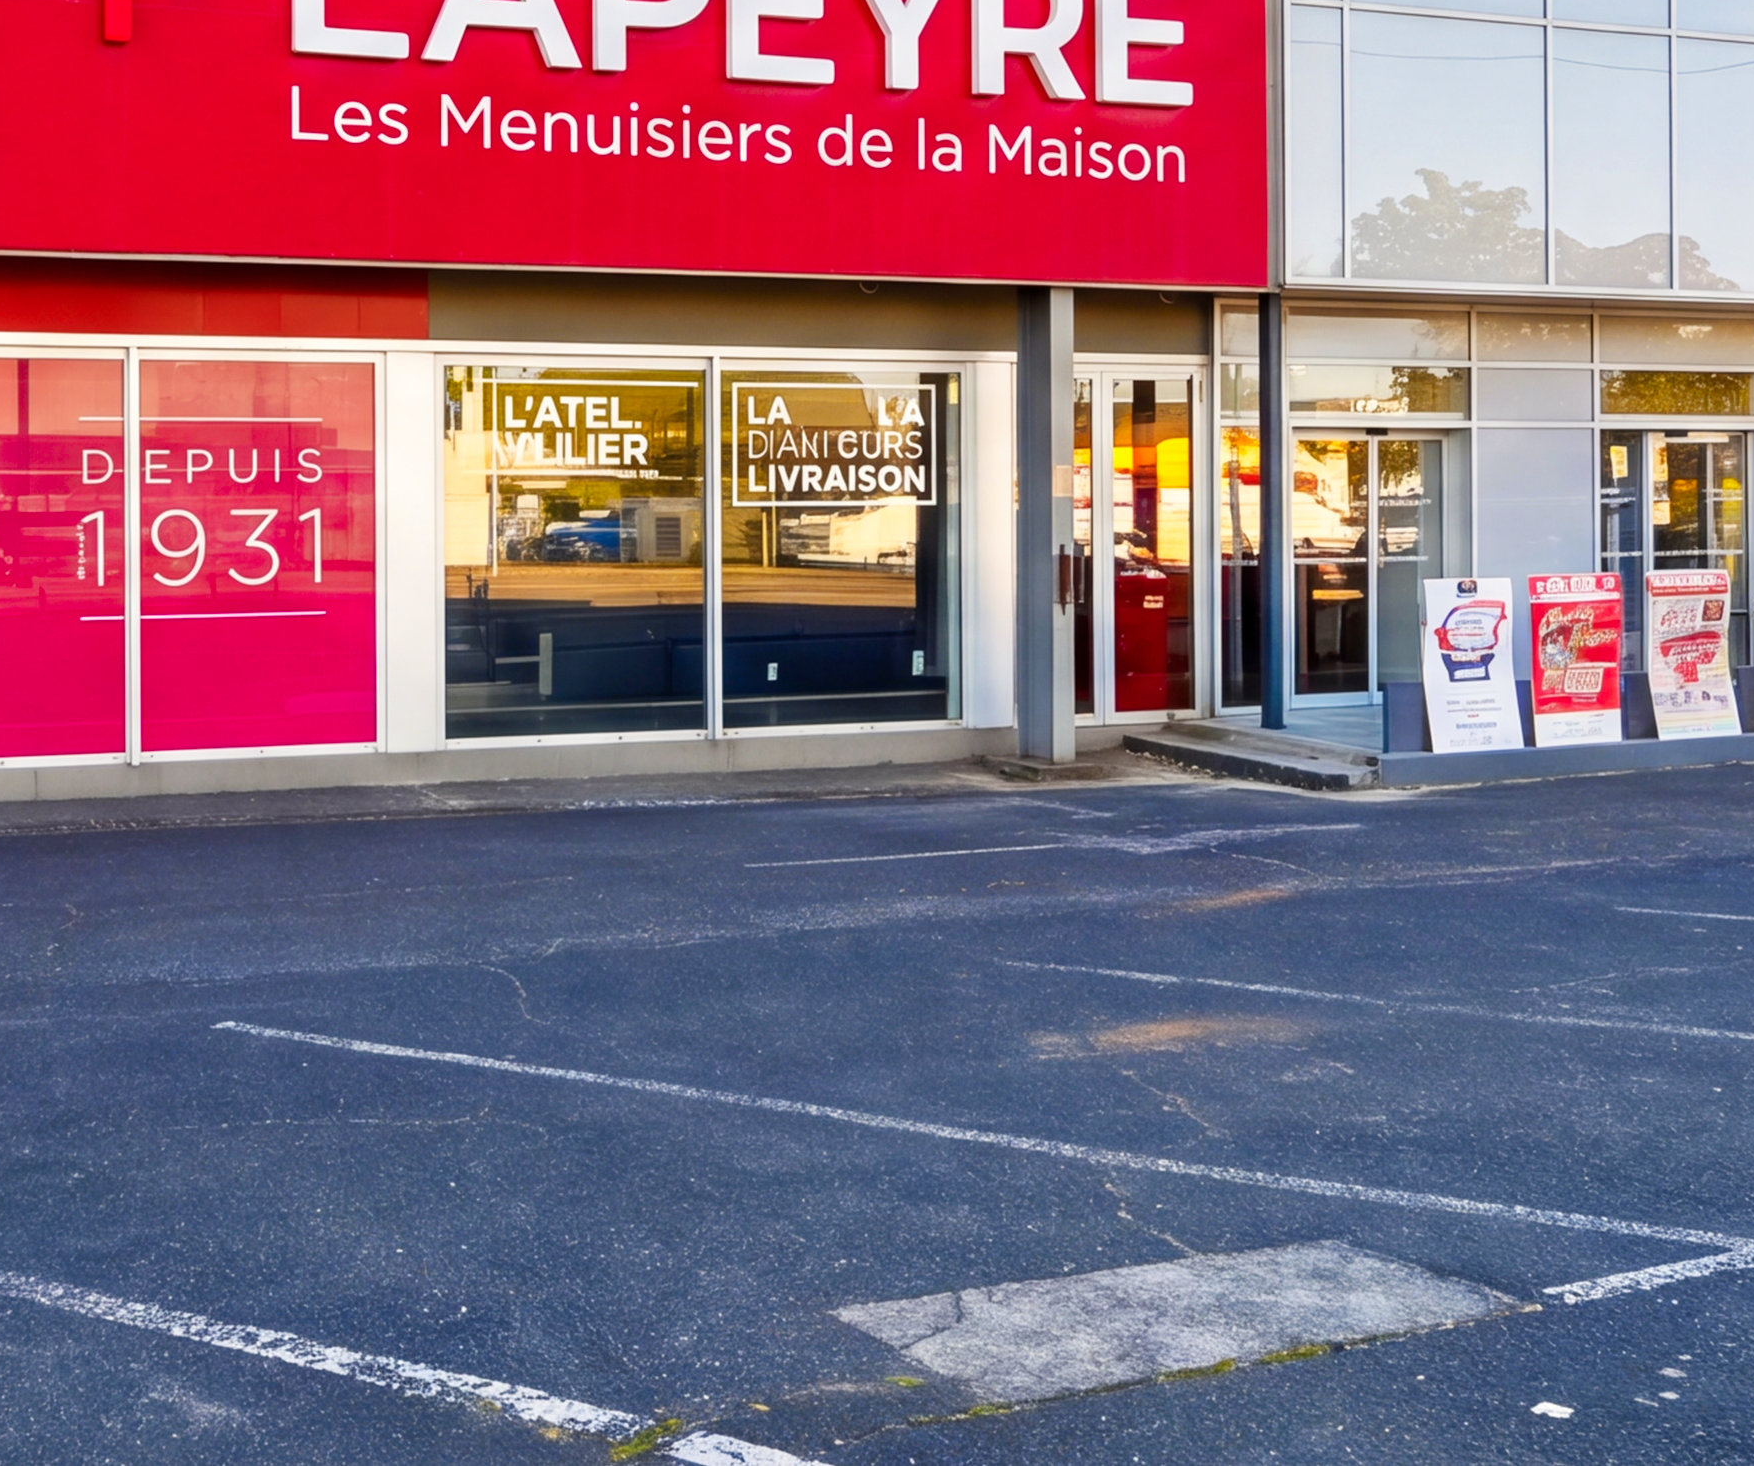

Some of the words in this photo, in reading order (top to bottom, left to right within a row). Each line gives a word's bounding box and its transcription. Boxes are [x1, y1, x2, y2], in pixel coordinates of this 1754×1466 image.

[291, 85, 409, 145] Les
[440, 93, 792, 164] Menuisiers
[817, 113, 893, 168] de
[918, 117, 962, 172] la
[988, 124, 1185, 183] Maison
[748, 396, 792, 425] LA
[81, 447, 324, 485] DEPUIS
[748, 464, 926, 493] LIVRAISON
[81, 507, 324, 587] 1931
